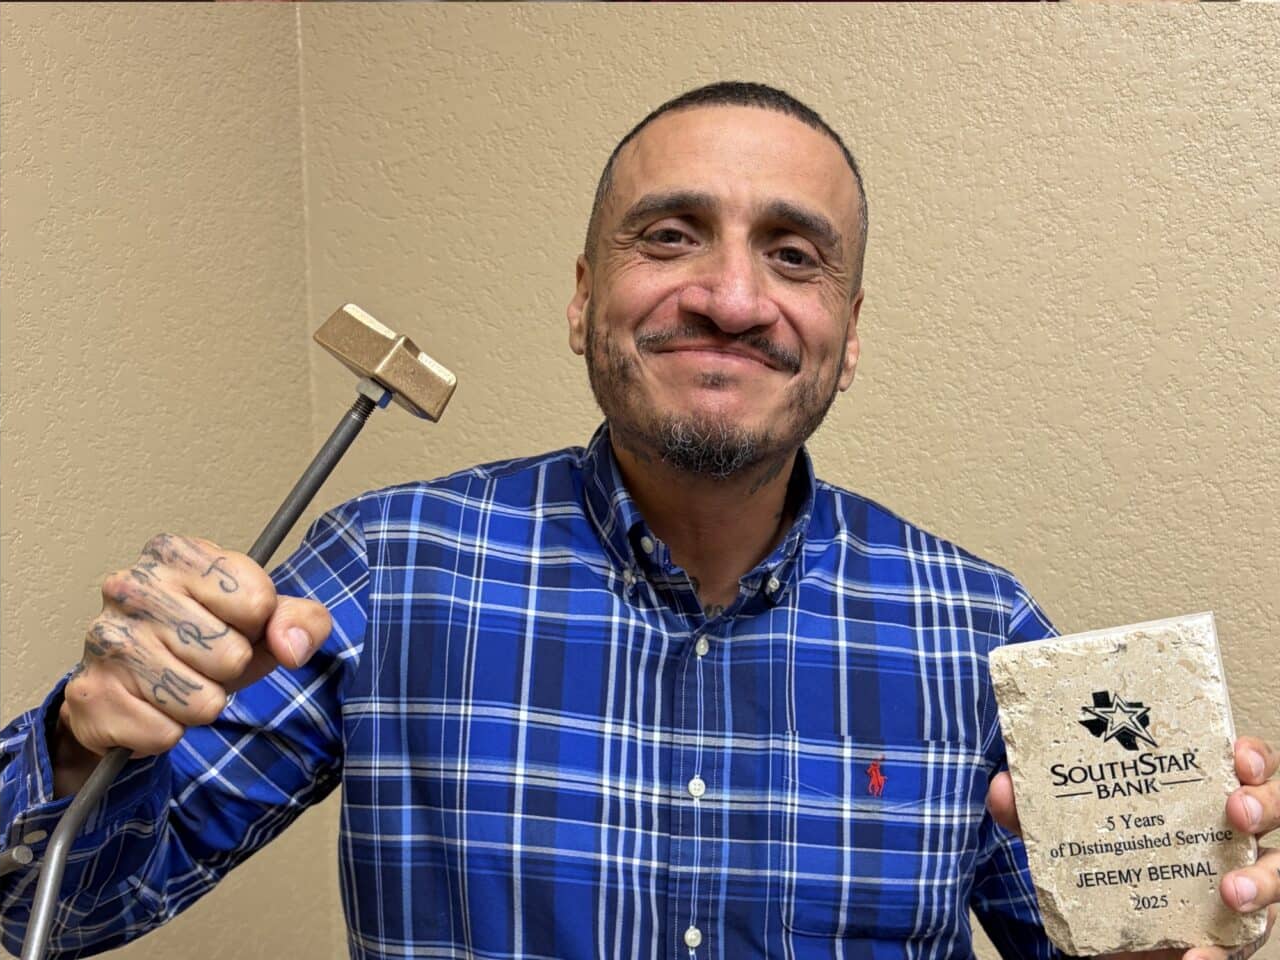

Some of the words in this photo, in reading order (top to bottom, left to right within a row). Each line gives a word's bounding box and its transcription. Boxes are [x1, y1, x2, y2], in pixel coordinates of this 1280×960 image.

[1096, 777, 1160, 799] BANK
[1106, 815, 1116, 831] 5
[1120, 814, 1165, 830] Years
[1050, 841, 1066, 858] of
[1070, 832, 1171, 856] Distinguished
[1175, 828, 1233, 846] Service
[1076, 868, 1142, 888] JEREMY
[1148, 861, 1217, 882] BERNAL
[1133, 895, 1169, 911] 2025
